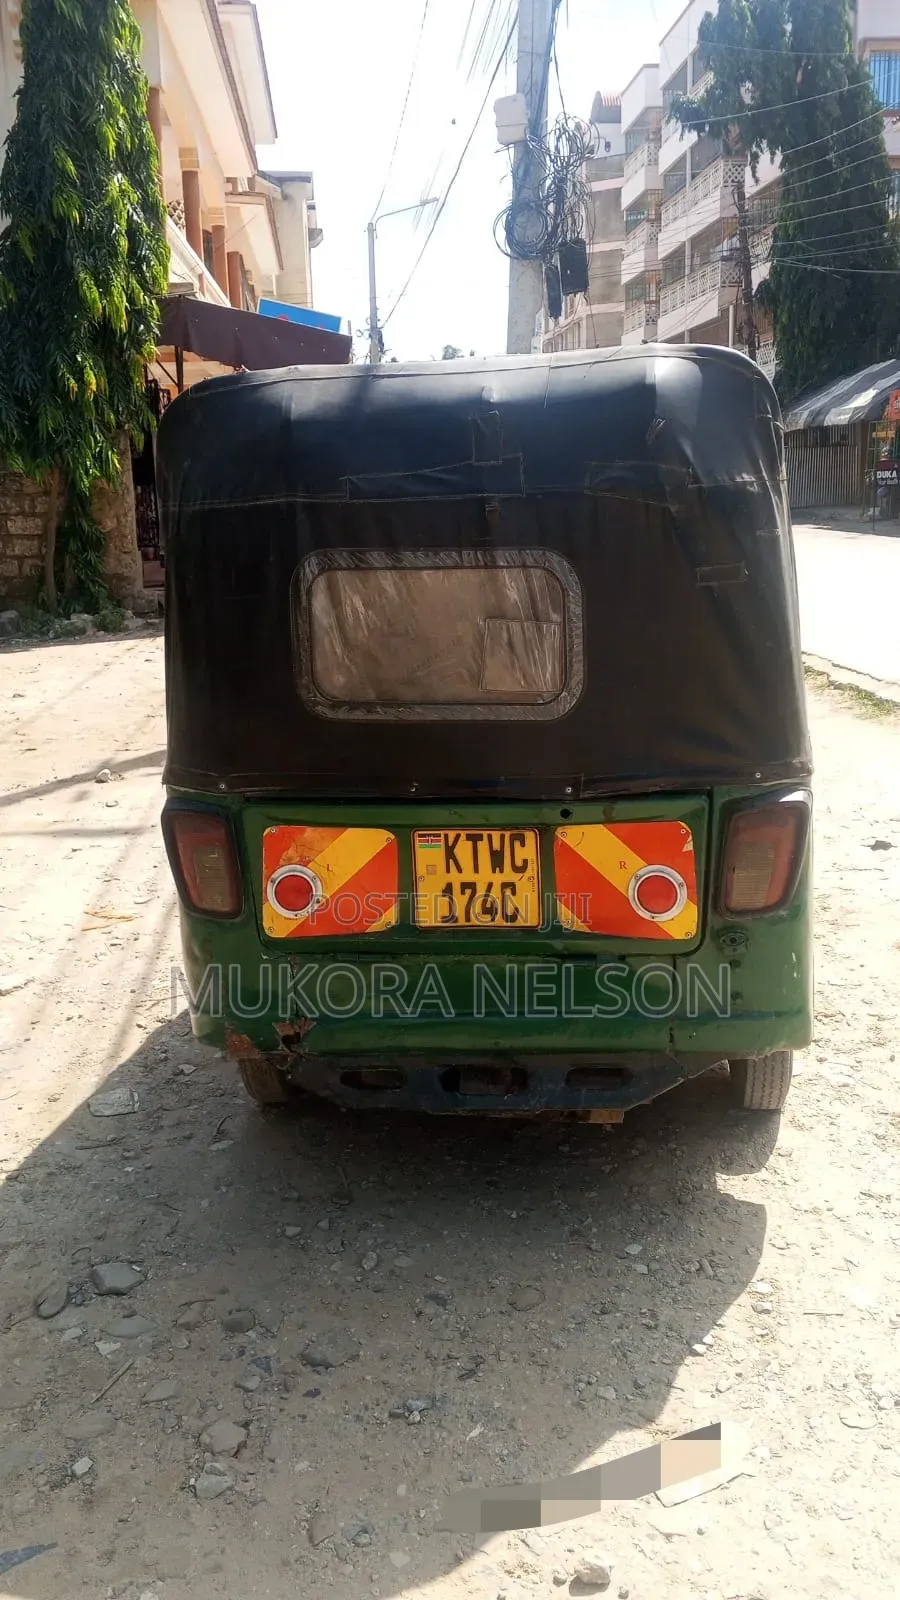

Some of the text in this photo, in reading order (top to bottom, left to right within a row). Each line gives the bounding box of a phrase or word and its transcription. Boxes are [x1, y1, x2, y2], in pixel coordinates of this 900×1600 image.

[876, 470, 897, 479] DUKA
[443, 832, 529, 875] KTWC
[619, 861, 627, 870] R
[440, 881, 520, 924] 174C
